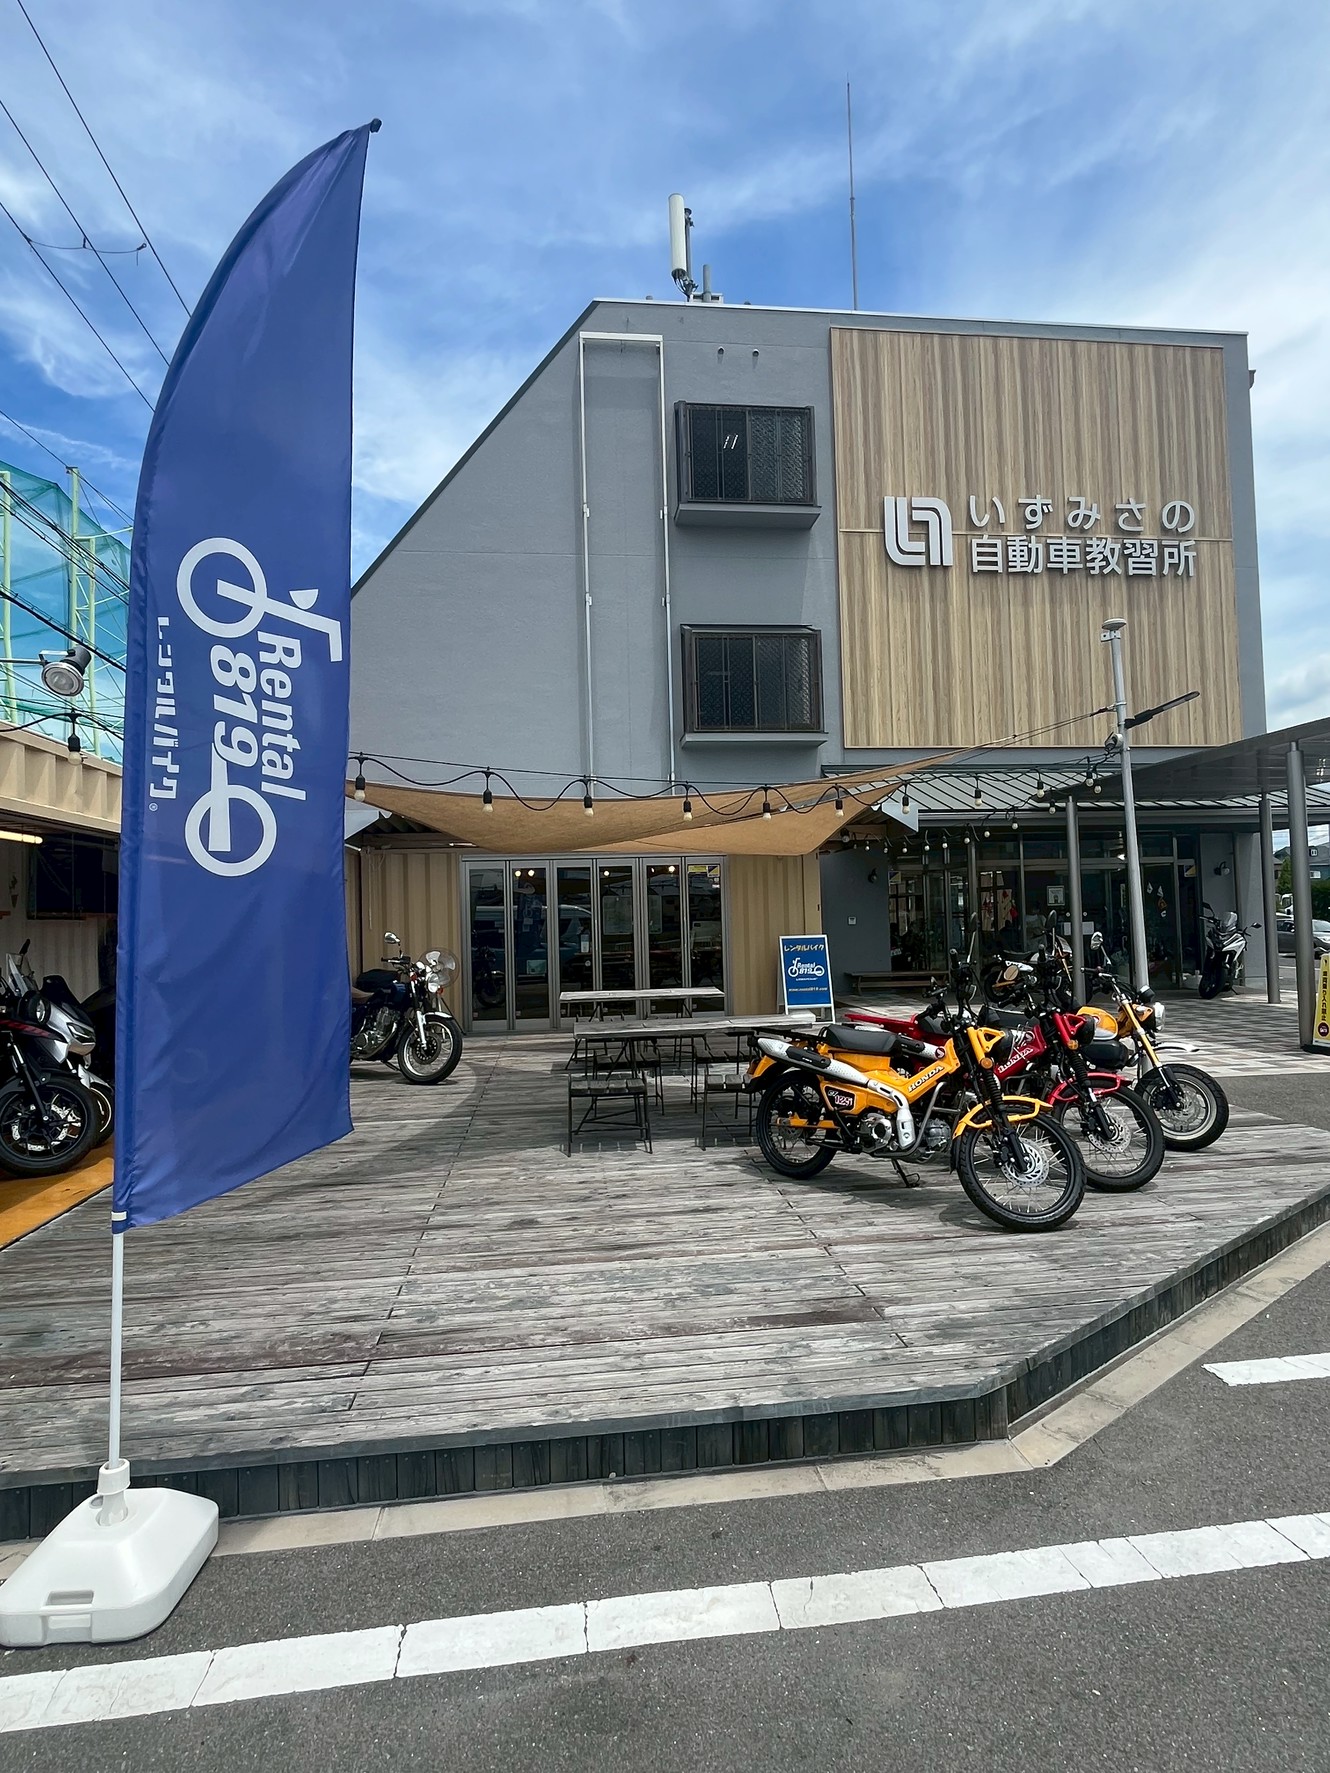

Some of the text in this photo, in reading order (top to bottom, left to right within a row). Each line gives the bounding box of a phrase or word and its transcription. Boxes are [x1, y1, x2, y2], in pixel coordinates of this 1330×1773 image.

[969, 494, 1195, 533] いずみさの
[970, 535, 1197, 577] 自動車教習所
[210, 644, 258, 768] 819
[256, 630, 306, 801] Rental
[784, 944, 825, 952] レンタルバイク
[908, 1066, 945, 1092] HONDA
